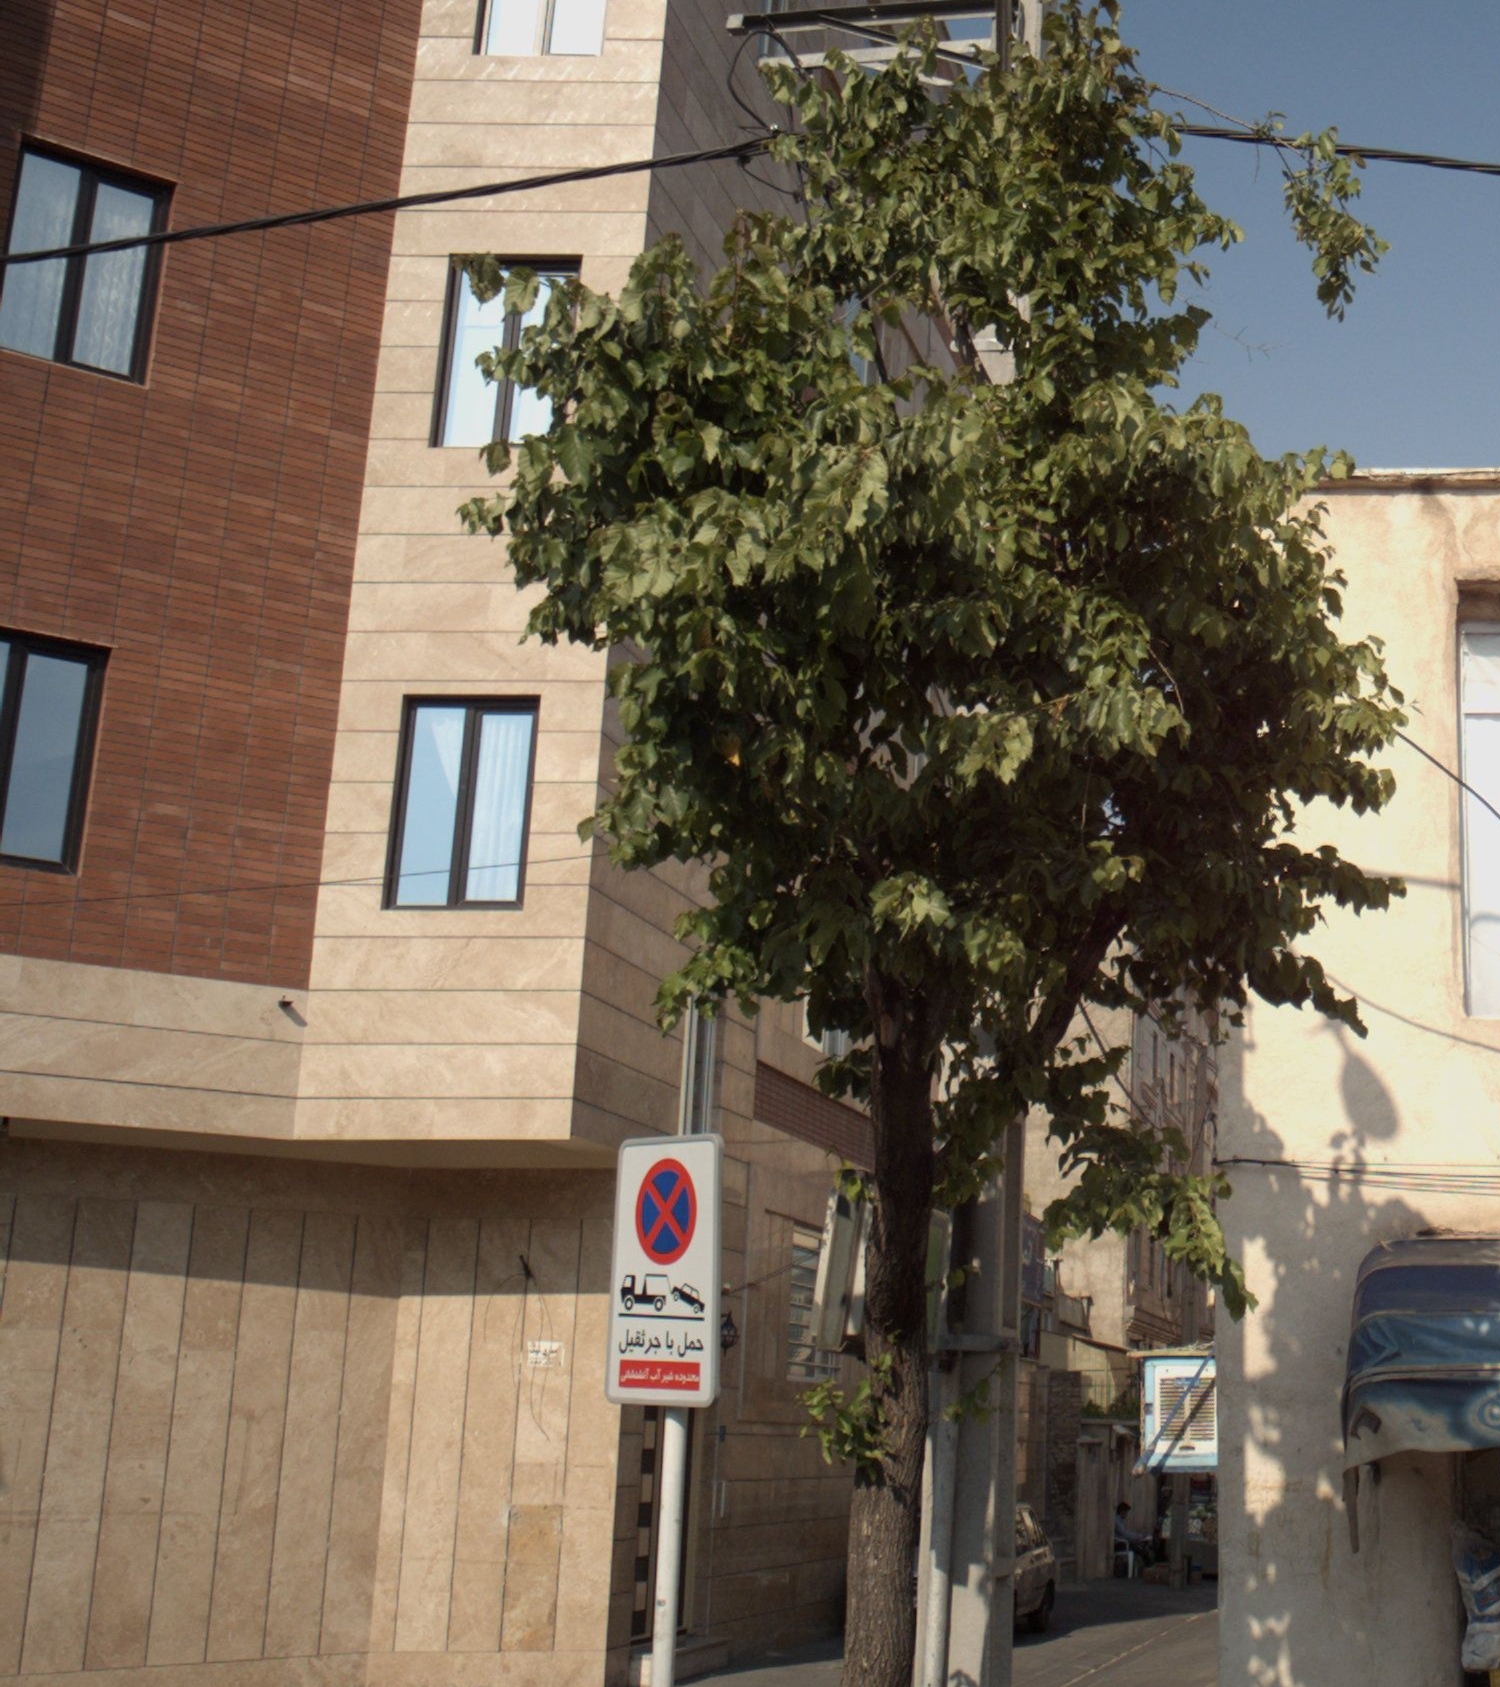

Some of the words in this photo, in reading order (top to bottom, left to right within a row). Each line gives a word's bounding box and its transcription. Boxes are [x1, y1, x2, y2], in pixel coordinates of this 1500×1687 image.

[618, 1329, 662, 1354] جرثقیل
[666, 1330, 674, 1355] با
[677, 1331, 704, 1358] حمل
[649, 1368, 661, 1382] آب
